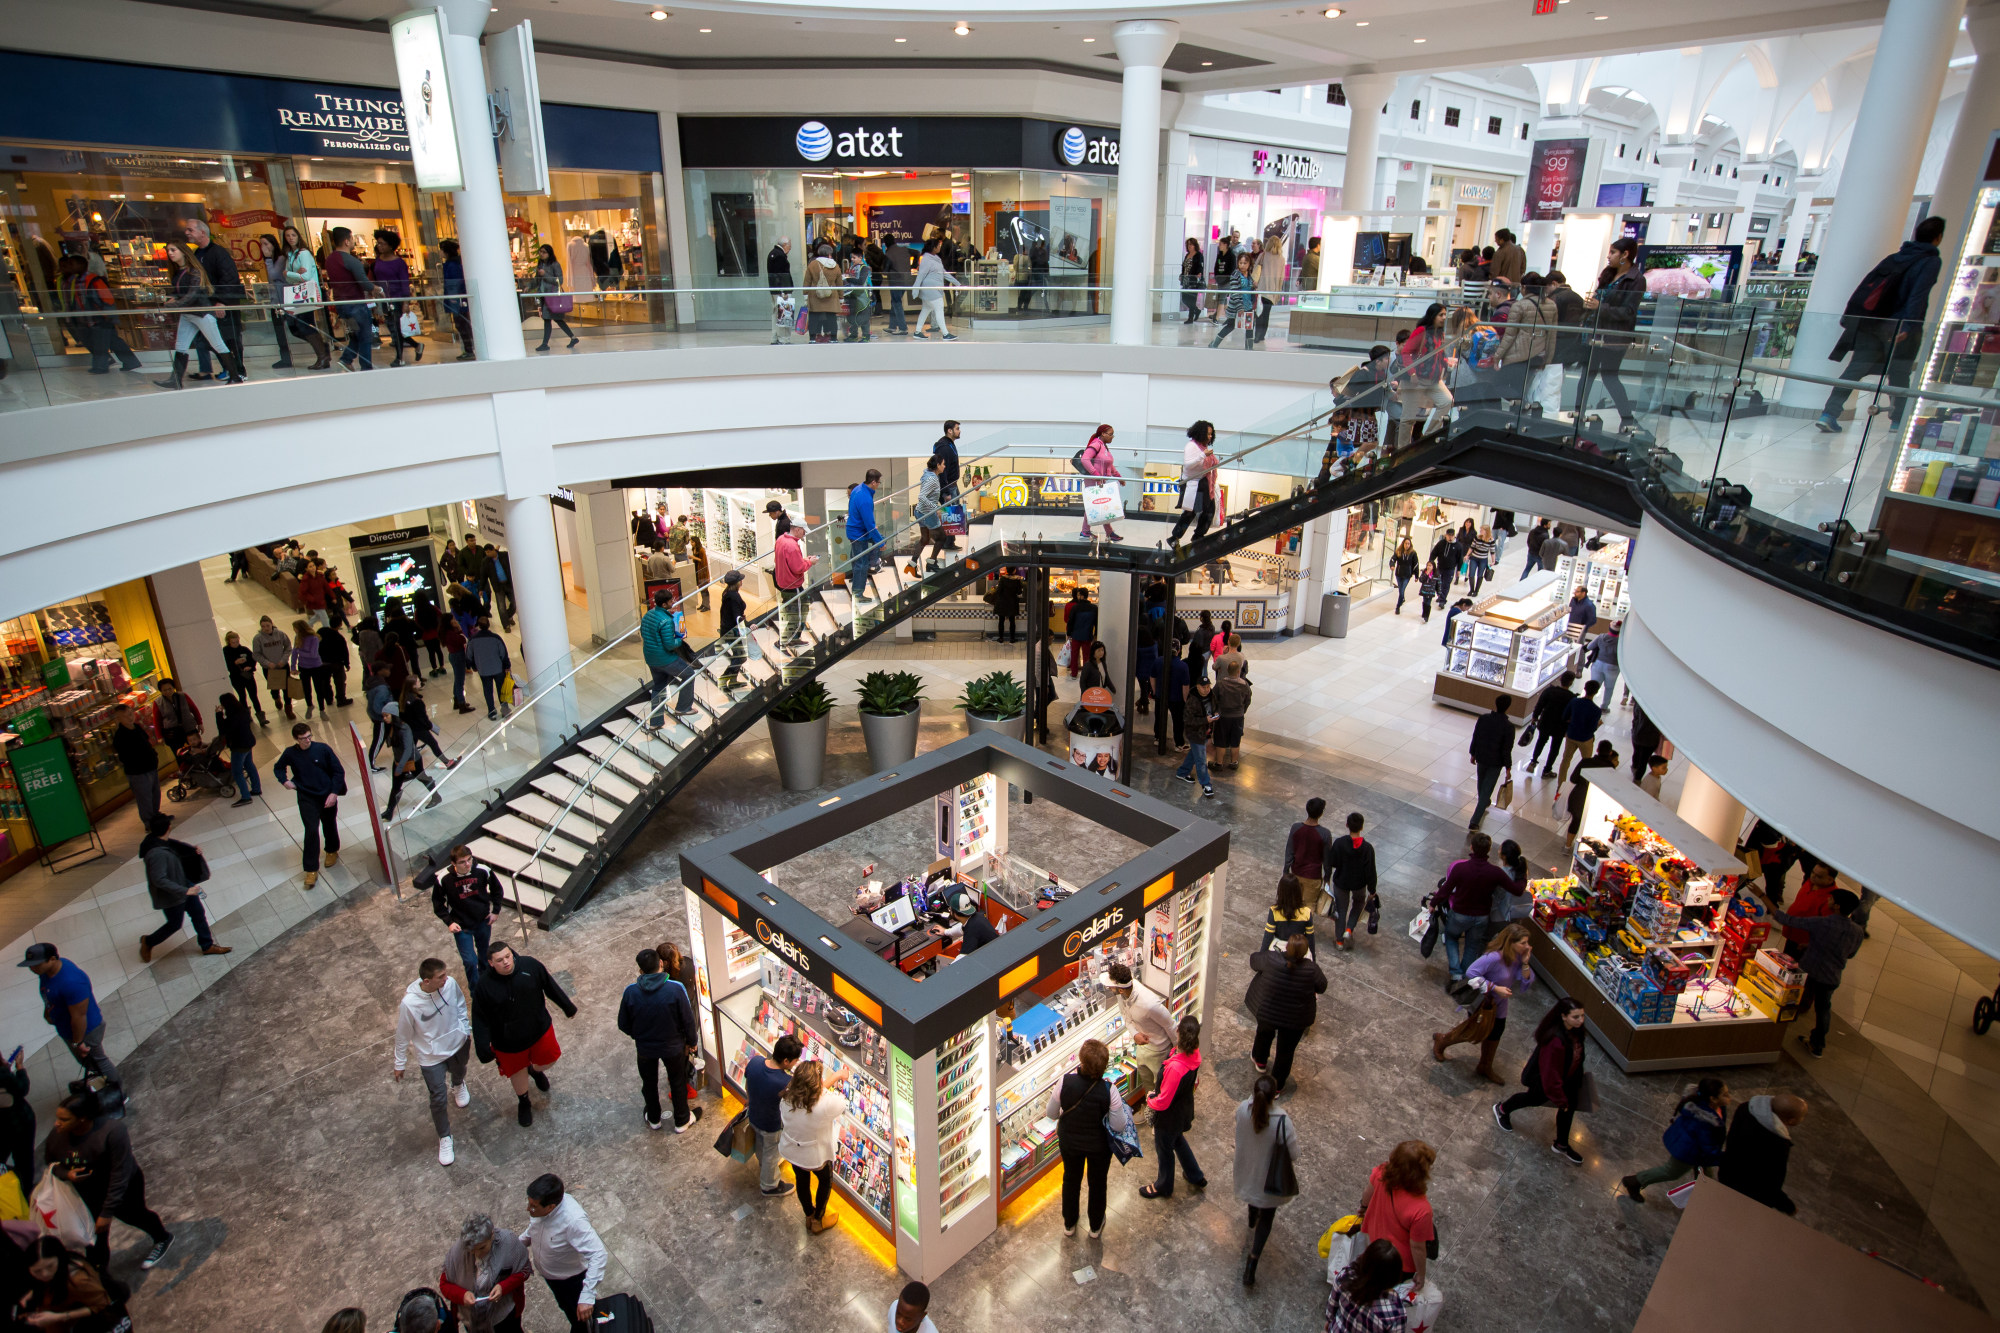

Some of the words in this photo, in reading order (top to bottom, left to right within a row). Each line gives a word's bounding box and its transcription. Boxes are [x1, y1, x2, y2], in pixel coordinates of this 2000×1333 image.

[1536, 0, 1555, 14] EXIT
[277, 108, 408, 132] REMEMBE
[323, 138, 391, 151] PERSONALIZED
[392, 143, 412, 152] GIF
[836, 126, 903, 158] at&t
[1088, 136, 1120, 165] at&
[369, 530, 410, 543] Directory
[24, 772, 63, 793] FREE!
[462, 883, 473, 893] K
[756, 918, 809, 970] Cellairis
[1063, 907, 1123, 957] Cellairis
[895, 1057, 908, 1100] DEVICE
